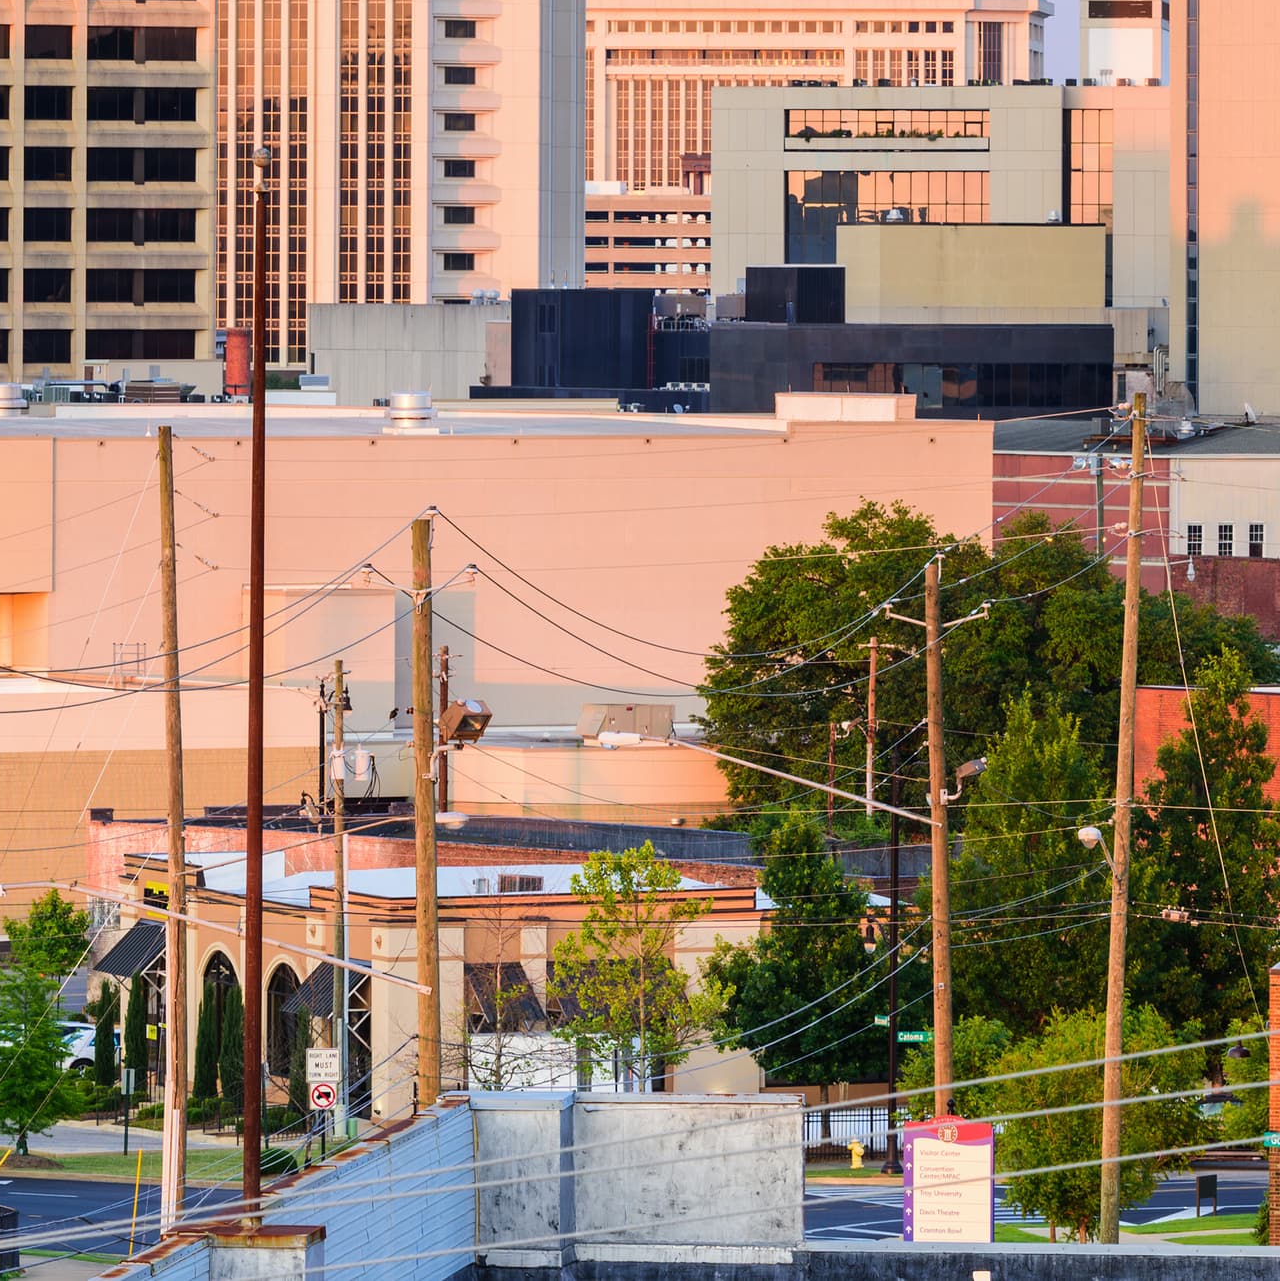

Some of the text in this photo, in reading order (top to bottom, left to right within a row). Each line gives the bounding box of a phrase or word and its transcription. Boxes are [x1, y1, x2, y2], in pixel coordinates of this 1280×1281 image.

[898, 1031, 923, 1041] Catoma
[314, 1061, 332, 1069] MUST
[940, 1149, 961, 1157] Center
[920, 1189, 962, 1198] Troy University
[937, 1208, 961, 1216] Theatre
[919, 1226, 946, 1234] Cramton
